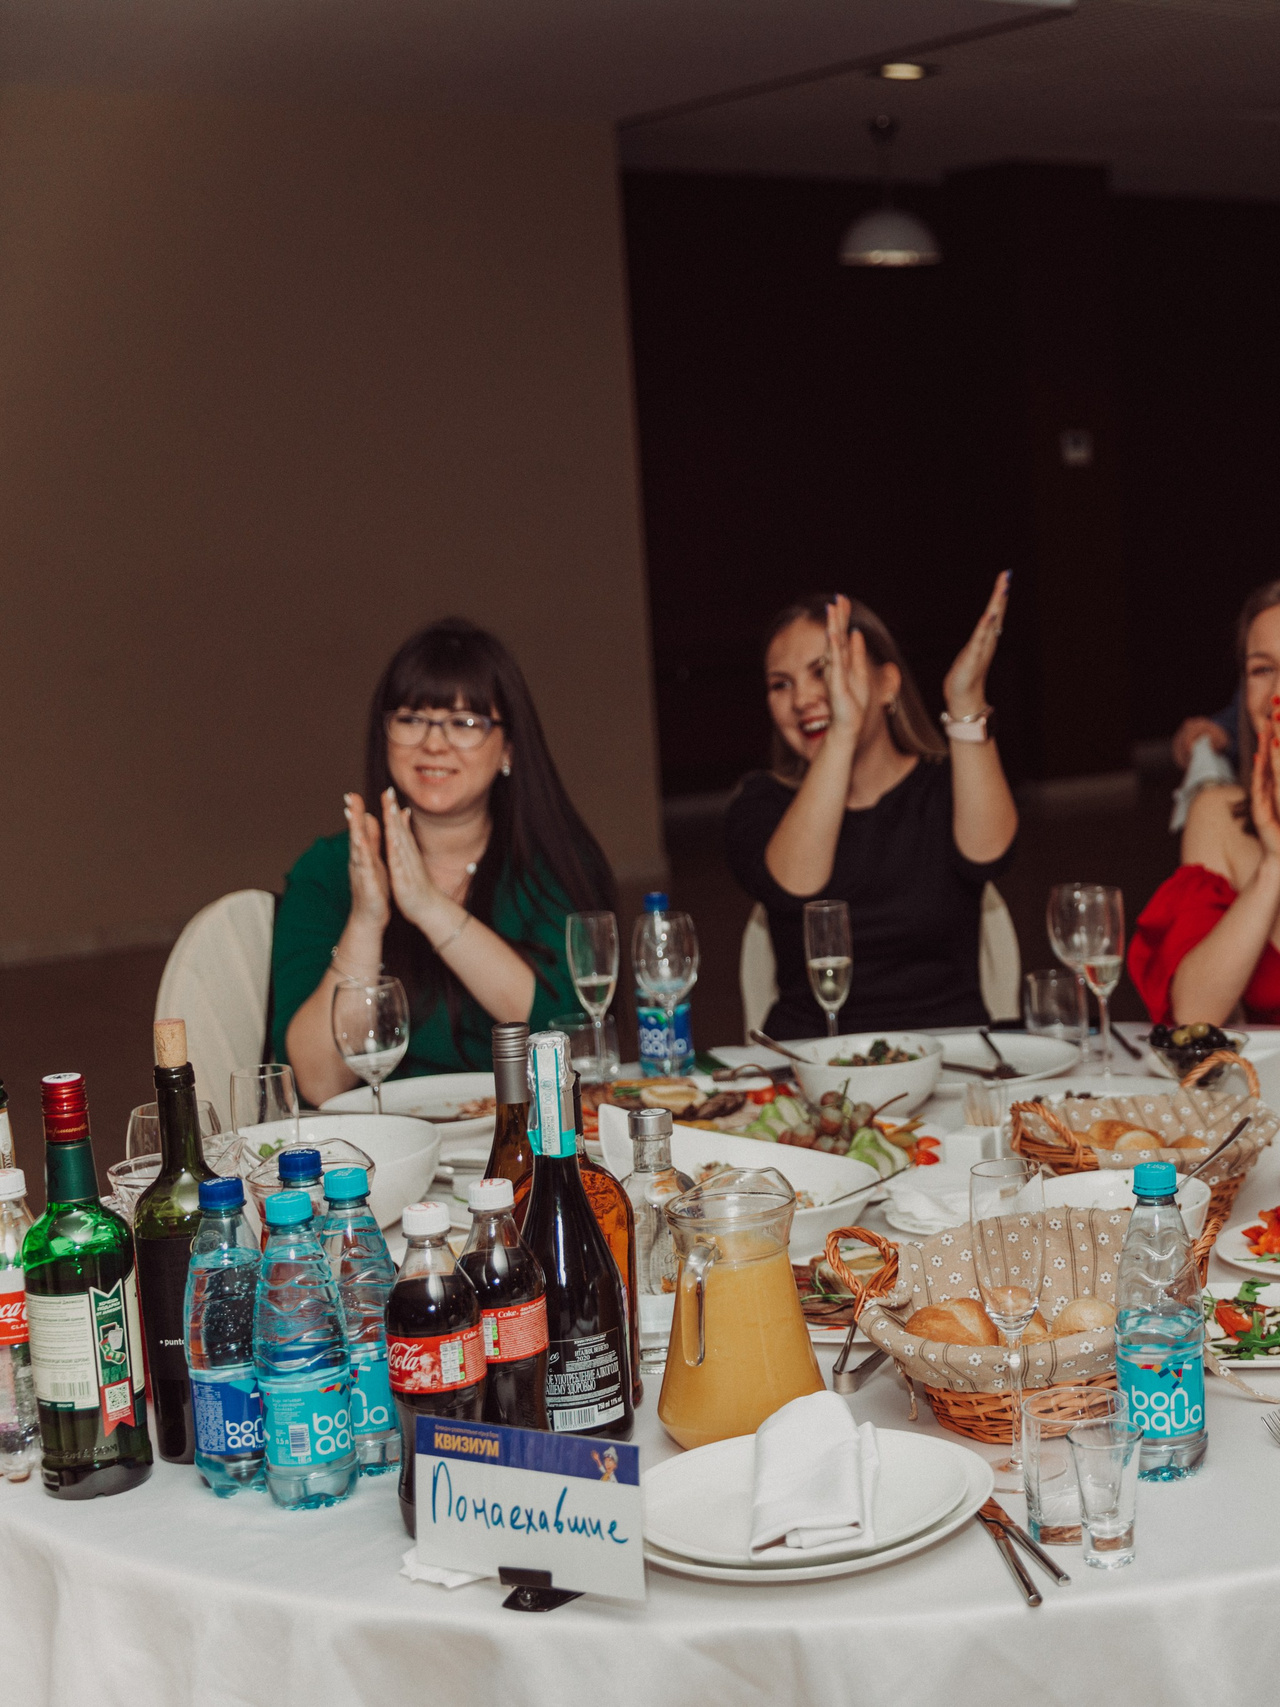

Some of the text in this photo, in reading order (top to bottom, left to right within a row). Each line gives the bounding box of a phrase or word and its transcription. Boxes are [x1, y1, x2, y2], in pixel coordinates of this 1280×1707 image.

[546, 1383, 566, 1396] АШЕМУ
[1131, 1384, 1189, 1411] bon
[313, 1409, 351, 1435] bo
[1132, 1404, 1202, 1435] aqua
[227, 1432, 265, 1449] aqu
[315, 1429, 351, 1455] aq
[433, 1432, 500, 1459] КВИЗИУМ
